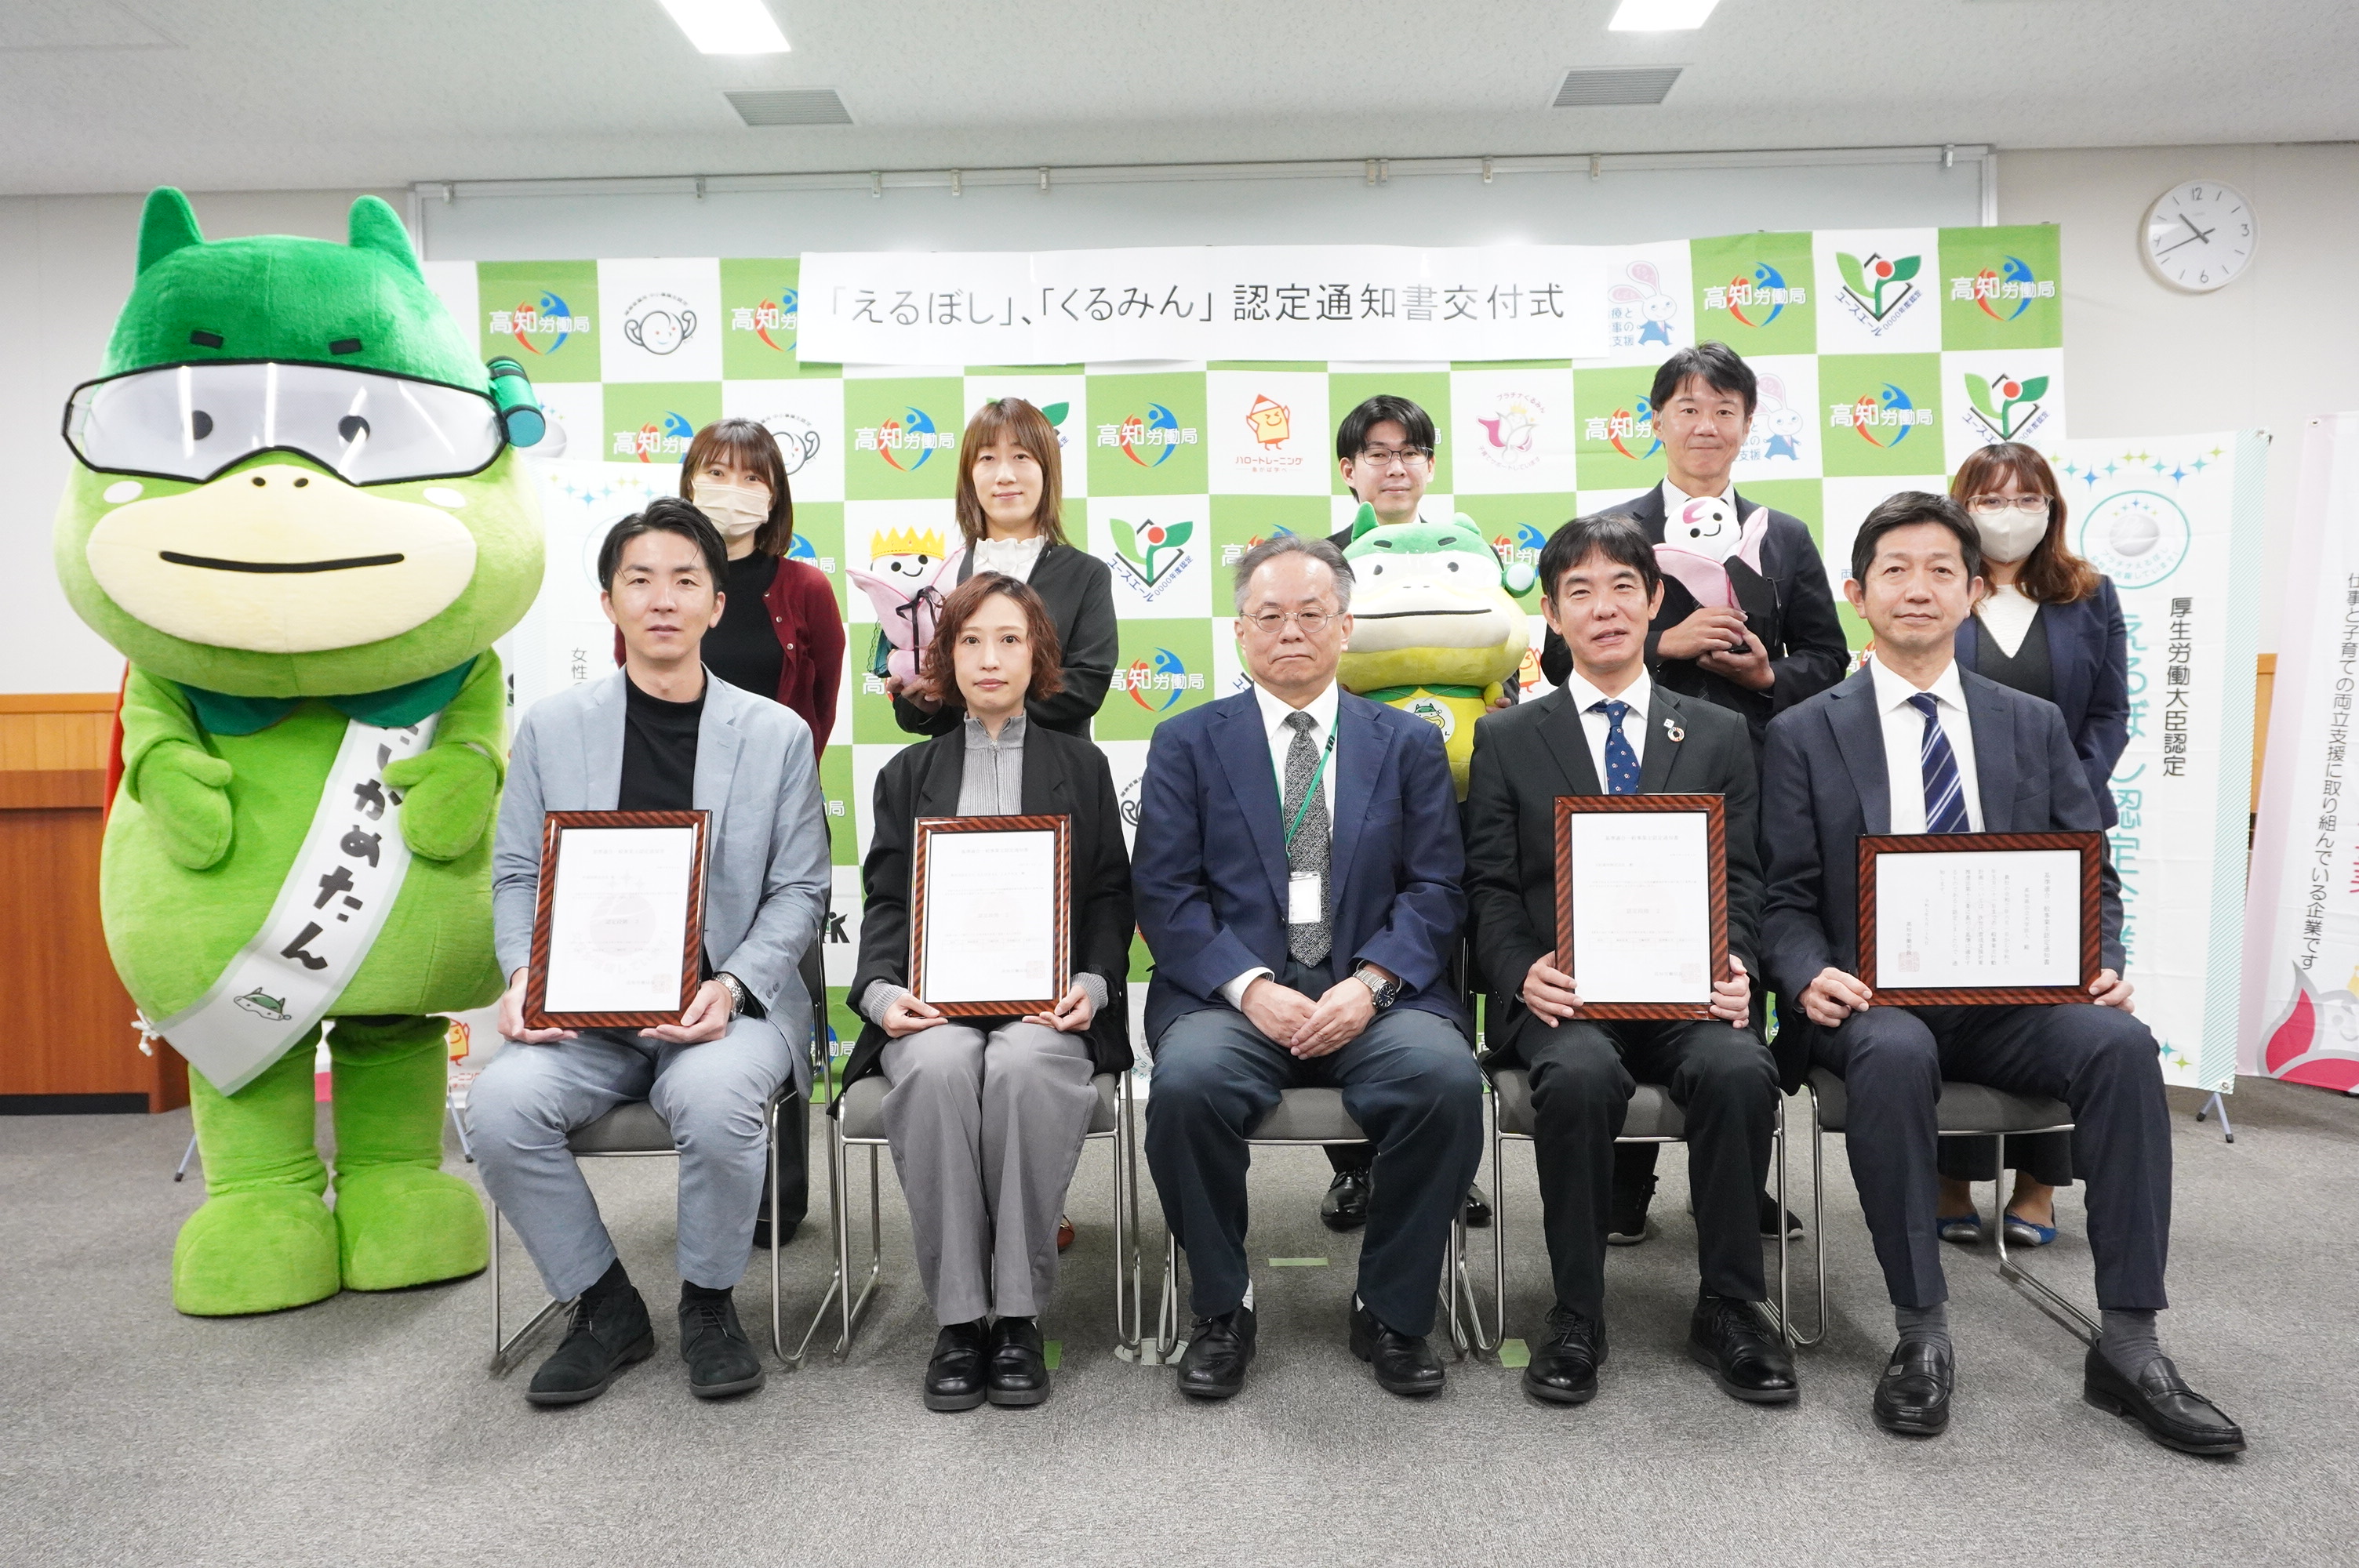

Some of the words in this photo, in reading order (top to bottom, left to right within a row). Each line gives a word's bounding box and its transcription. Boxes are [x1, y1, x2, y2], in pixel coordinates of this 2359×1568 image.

[2191, 187, 2203, 201] 12
[2152, 233, 2162, 247] 9
[2241, 223, 2250, 237] 3
[1950, 276, 2055, 301] 高知労働局
[2200, 269, 2209, 284] 6
[1703, 285, 1806, 310] 高知労働局
[489, 310, 590, 335] 高知労働局
[1835, 292, 1882, 336] ユースエール
[1830, 402, 1934, 428] 高知労働局
[854, 426, 955, 451] 高知労働局
[1096, 423, 1198, 448] 高知労働局
[1235, 456, 1304, 466] ハロートレーニング
[1107, 557, 1155, 603] ユースエール
[2162, 597, 2194, 777] 厚生労働大臣認定
